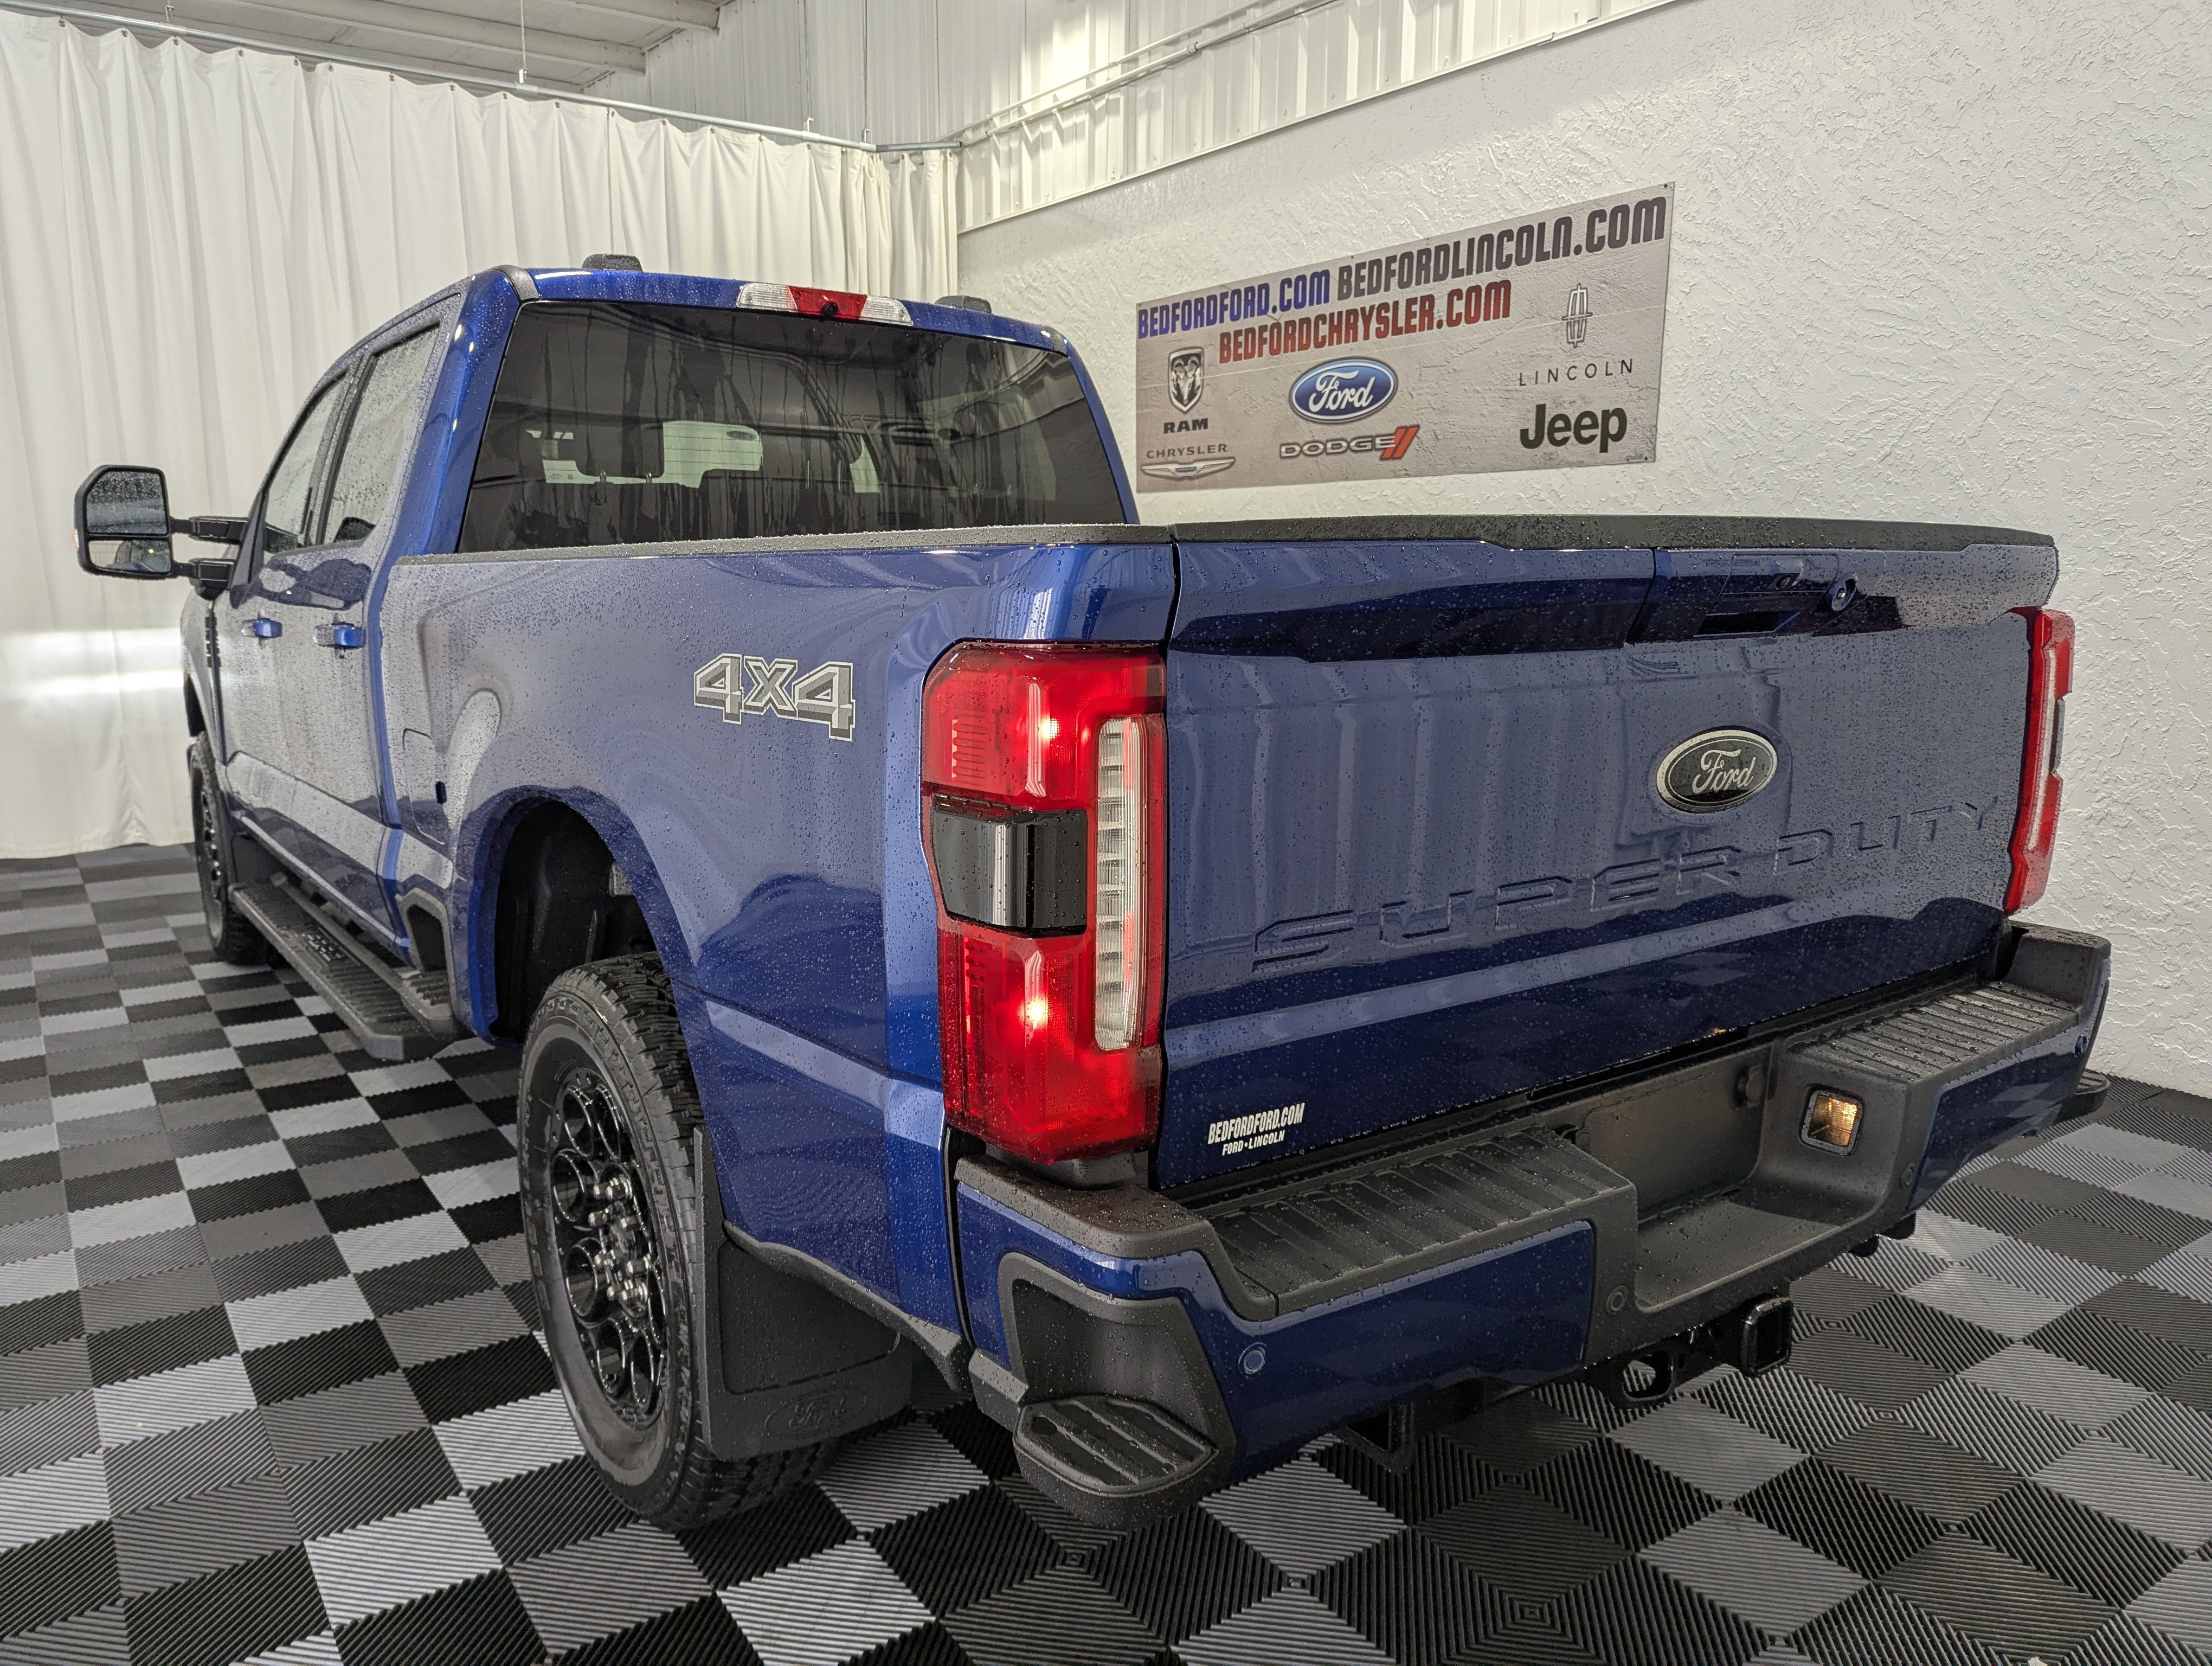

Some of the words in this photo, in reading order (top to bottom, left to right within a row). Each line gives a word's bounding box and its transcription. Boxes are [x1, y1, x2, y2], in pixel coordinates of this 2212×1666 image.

[1138, 270, 1330, 339] BEDFORDFORD.COM
[1338, 196, 1667, 301] BEDFORDLINCOLN.COM
[1219, 279, 1512, 364] BEDFORDCHRYSLER.COM
[1308, 370, 1376, 412] Ford
[1519, 358, 1633, 387] LINCOLN
[1163, 418, 1208, 434] RAM
[1279, 434, 1397, 458] DODGE
[1520, 403, 1627, 453] Jeep
[1146, 444, 1227, 459] CHRYSLER
[1692, 748, 1756, 794] Ford
[1252, 845, 1742, 972] SUPER
[1773, 795, 1999, 875] DUTY
[1207, 1103, 1306, 1144] BEDFORDFORD.COM
